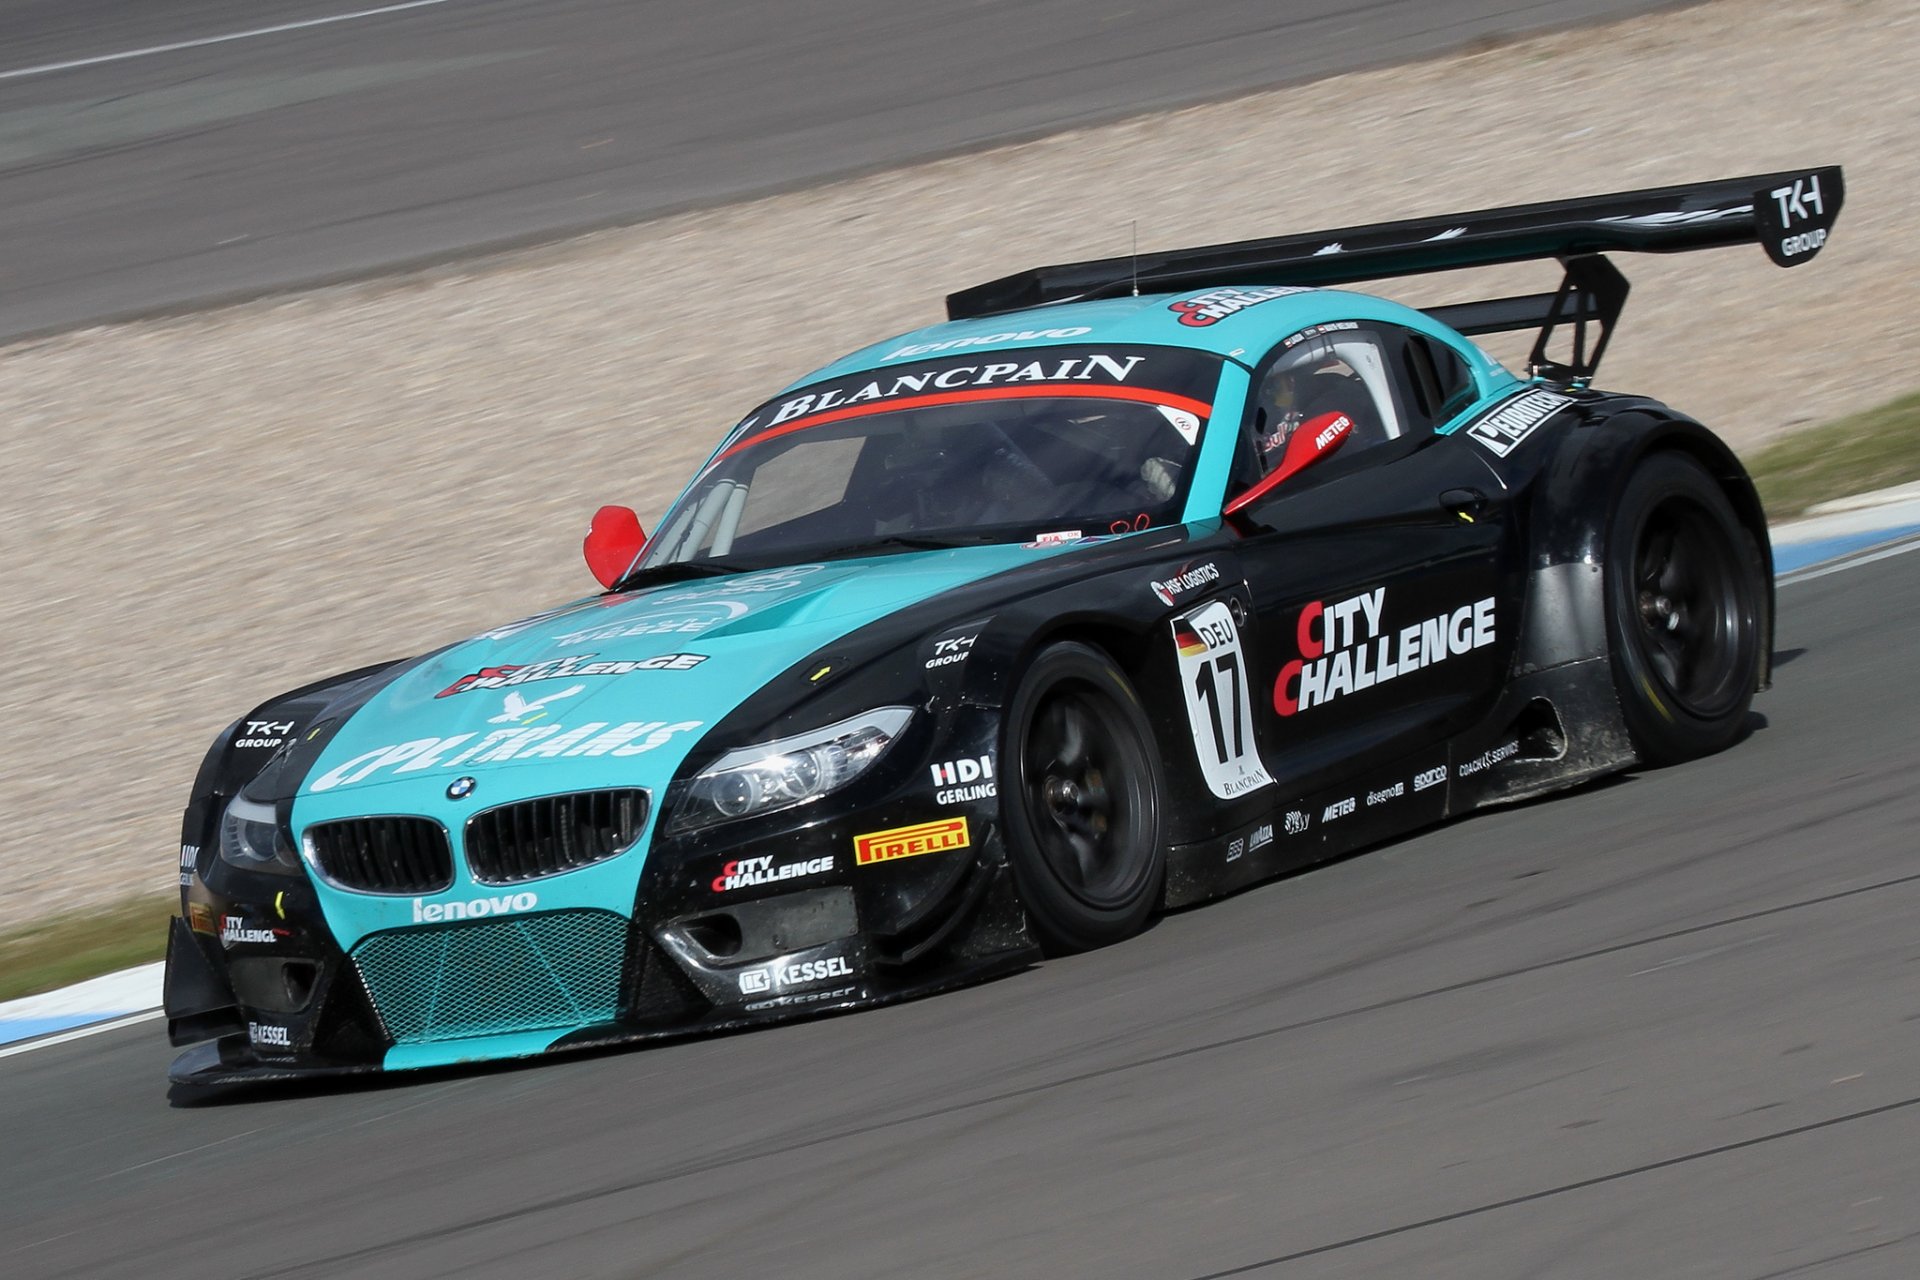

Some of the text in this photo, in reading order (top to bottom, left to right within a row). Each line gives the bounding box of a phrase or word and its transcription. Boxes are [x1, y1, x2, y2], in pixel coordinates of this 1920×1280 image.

[1771, 175, 1823, 228] TKH
[1781, 228, 1826, 256] GROUP
[1168, 288, 1244, 313] CITY
[880, 327, 1092, 361] lenovo
[765, 354, 1145, 428] BLANCPAIN
[1163, 563, 1219, 595] HSF LOGISTICS
[1199, 619, 1234, 650] DEU
[1297, 587, 1385, 659] CITY
[925, 651, 970, 669] GROUP
[934, 634, 978, 656] TKH
[1273, 597, 1495, 717] CHALLENGE
[435, 653, 710, 699] CHALLENGE
[479, 653, 600, 678] CITY
[1195, 652, 1246, 765] 17
[235, 738, 282, 748] GROUP
[246, 721, 295, 736] TKH
[309, 720, 704, 793] CPL TRANS
[930, 755, 993, 787] HDI
[936, 783, 997, 806] GERLING
[1223, 768, 1266, 797] BLANCPAIN
[858, 821, 965, 863] PIRELLI
[711, 856, 834, 892] CHALLENGE
[723, 855, 774, 876] CITY
[413, 892, 538, 923] lenovo
[775, 956, 854, 987] KESSEL
[257, 1025, 291, 1046] KESSEL
